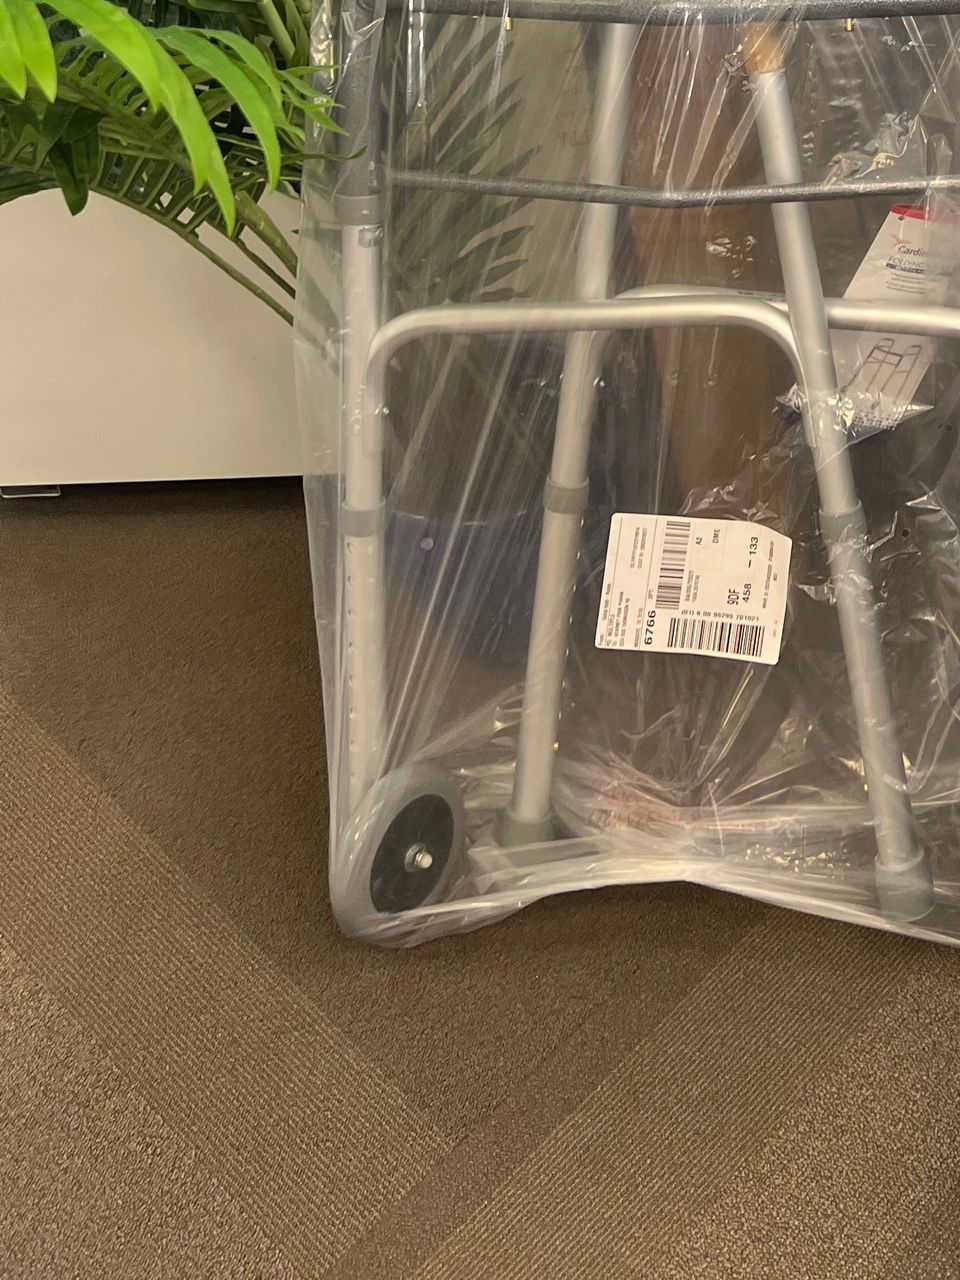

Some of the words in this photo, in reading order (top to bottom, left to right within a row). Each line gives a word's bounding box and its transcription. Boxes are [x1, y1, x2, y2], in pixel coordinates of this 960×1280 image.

[712, 528, 720, 544] DME
[742, 583, 752, 603] 458
[749, 536, 759, 556] 133
[644, 610, 657, 645] 6766
